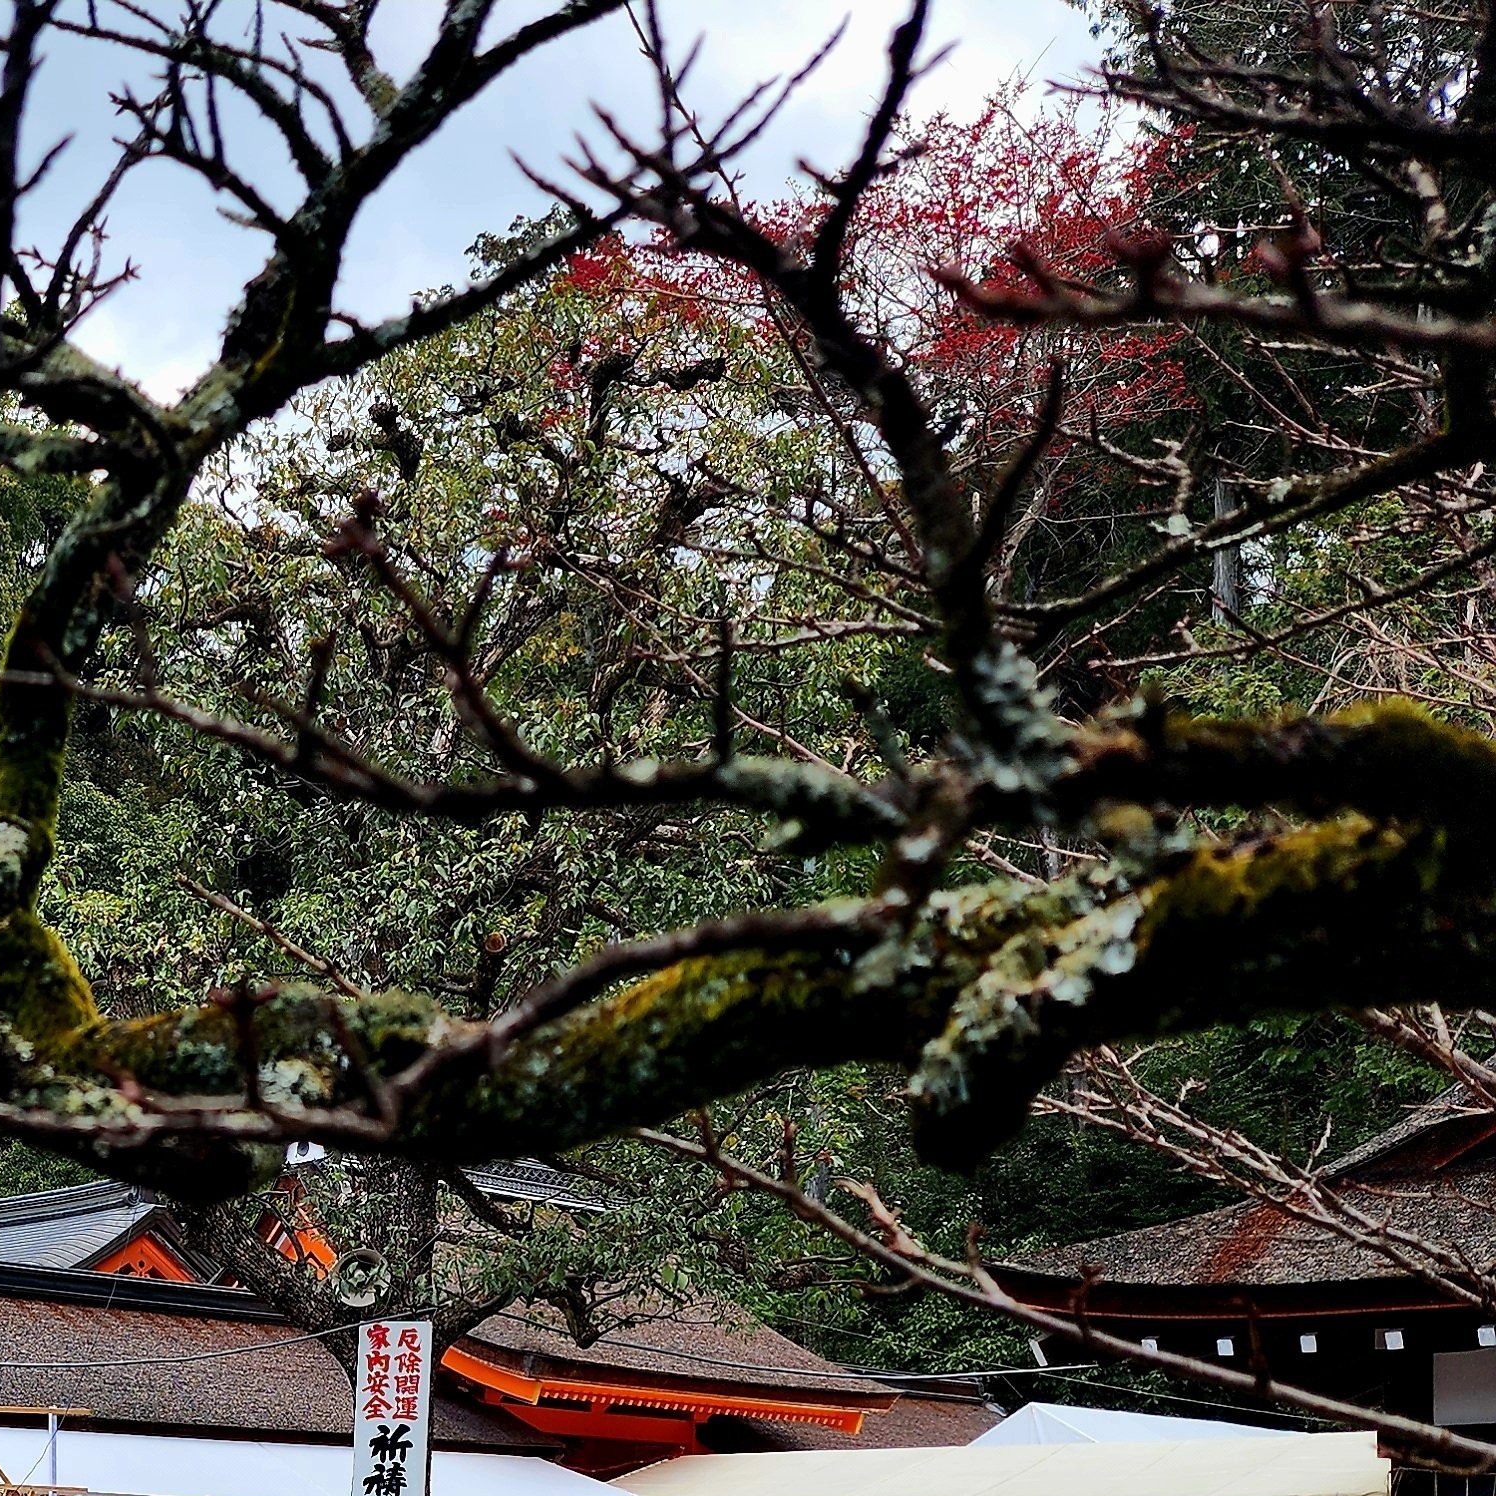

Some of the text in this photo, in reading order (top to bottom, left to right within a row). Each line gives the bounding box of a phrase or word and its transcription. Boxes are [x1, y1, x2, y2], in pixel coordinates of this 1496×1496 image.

[362, 1324, 392, 1420] 家内安全
[392, 1328, 422, 1420] 厄除開運
